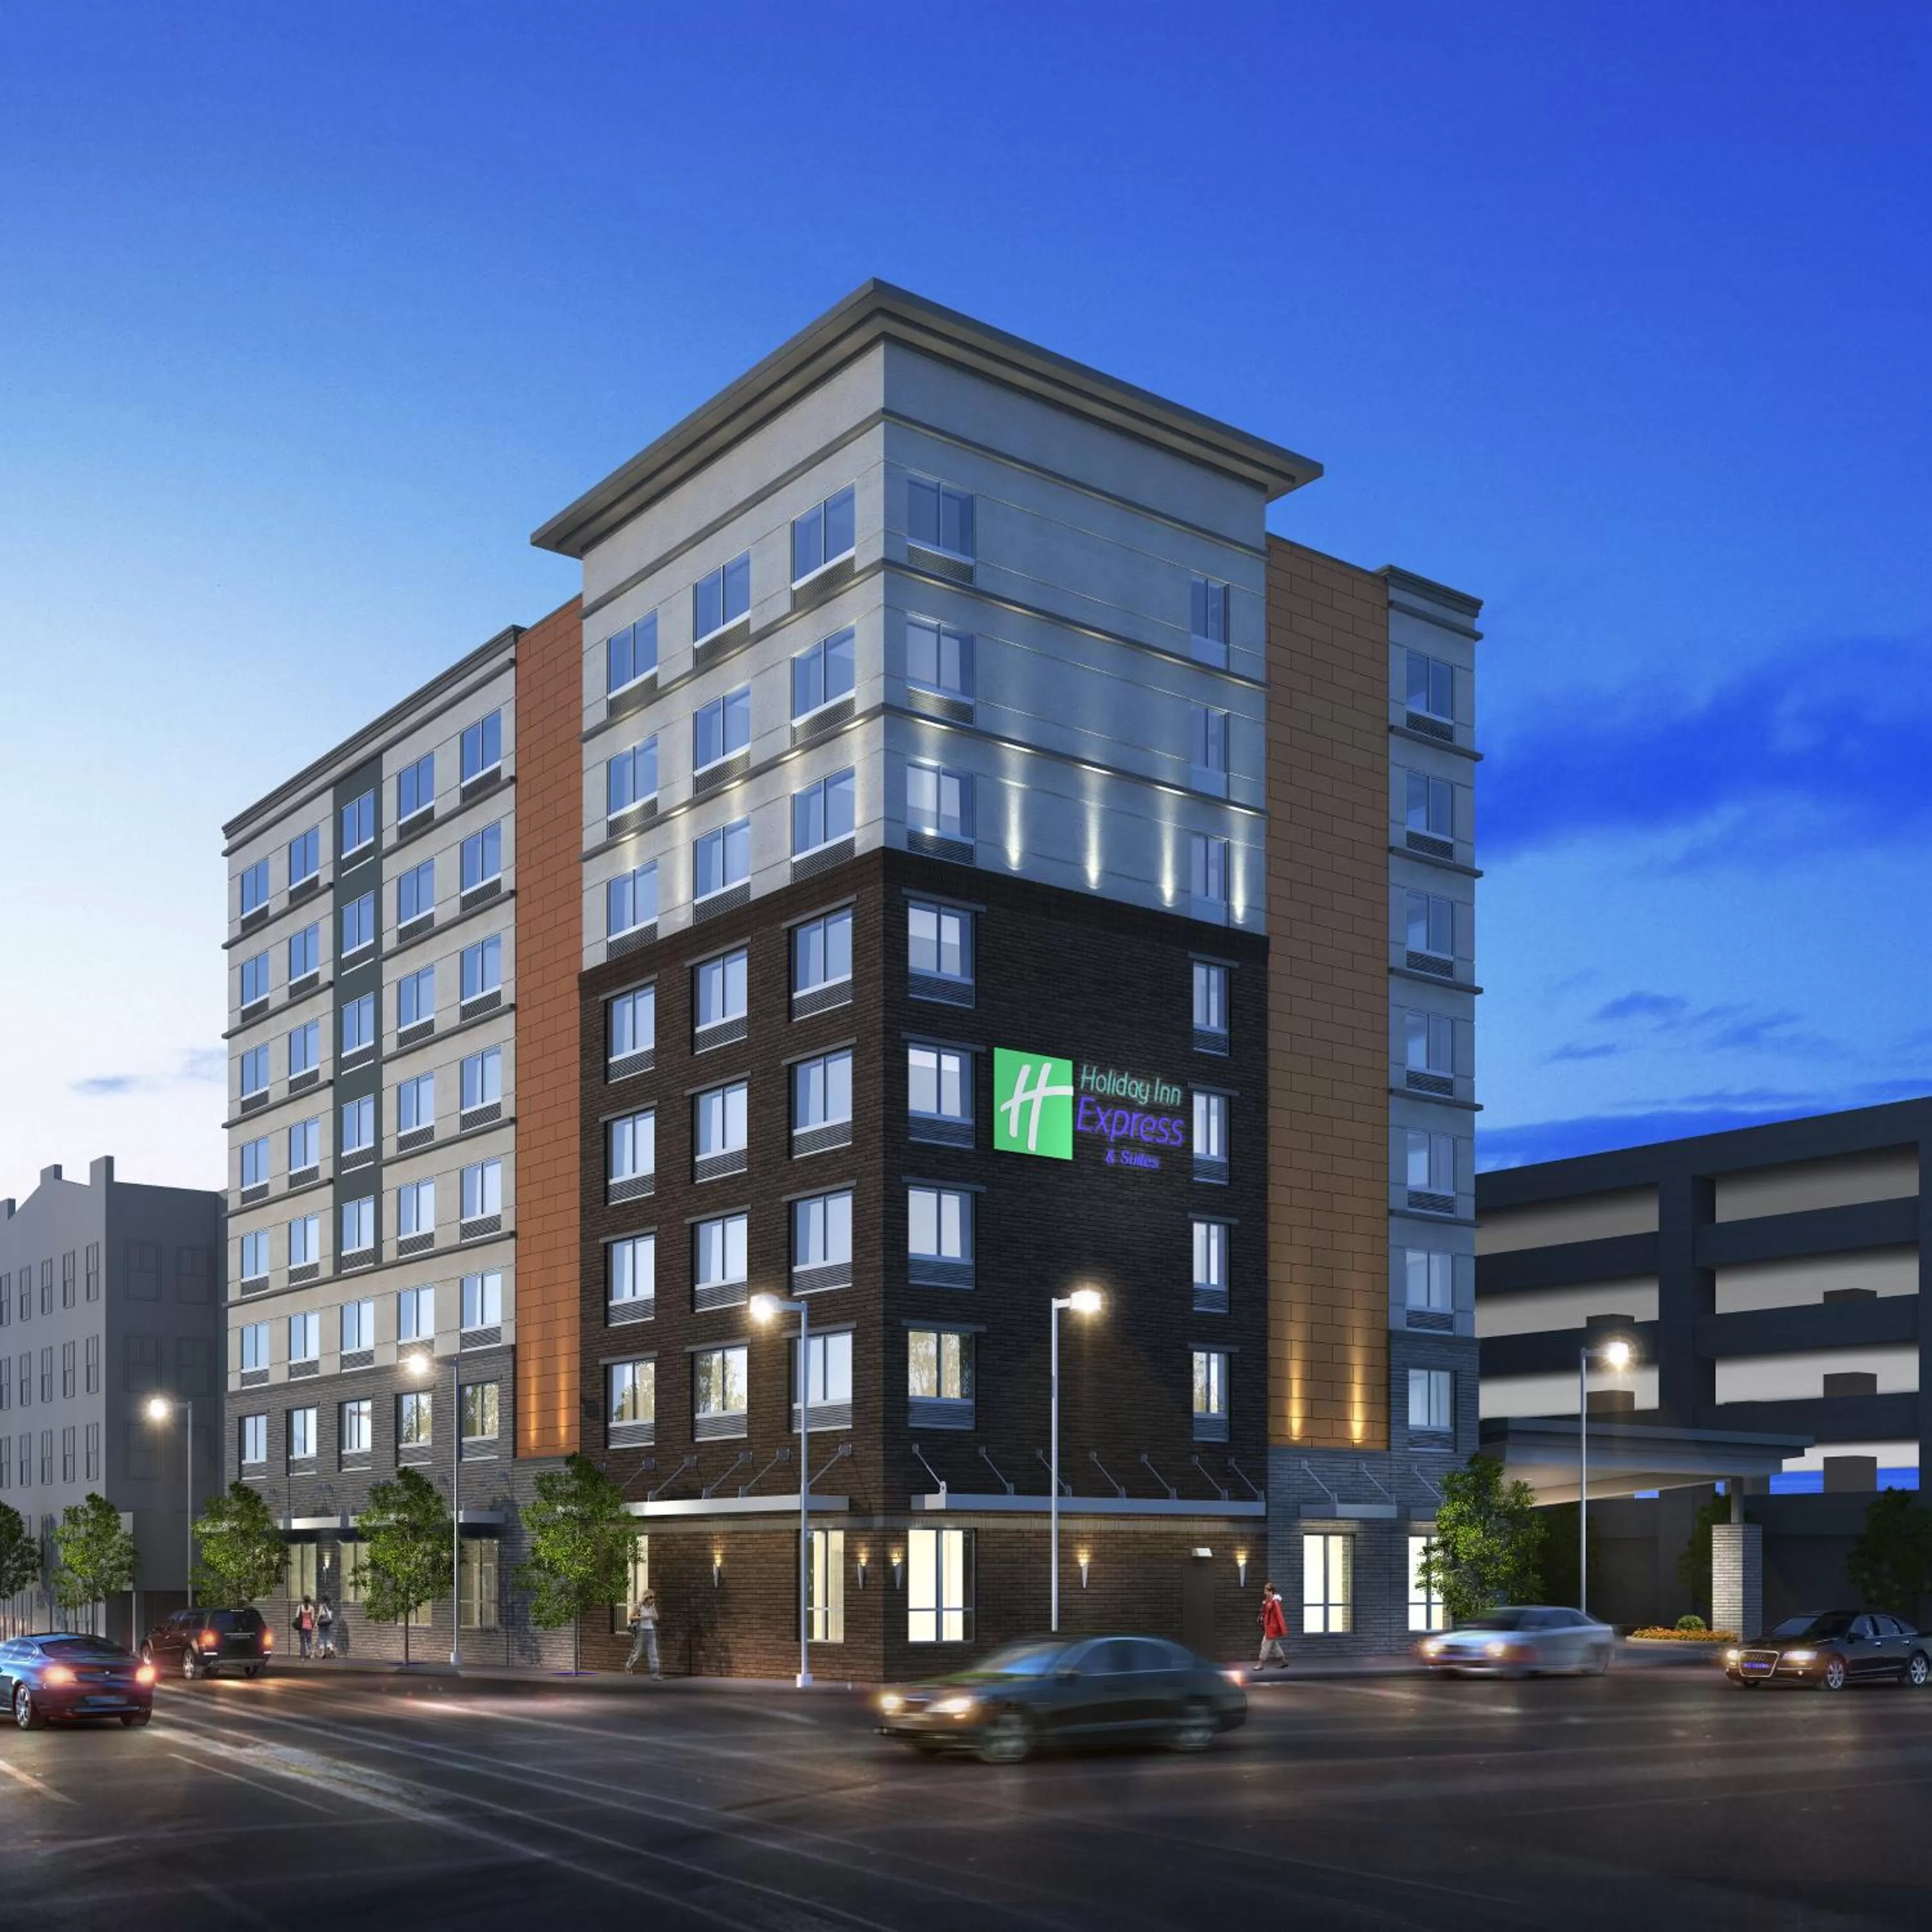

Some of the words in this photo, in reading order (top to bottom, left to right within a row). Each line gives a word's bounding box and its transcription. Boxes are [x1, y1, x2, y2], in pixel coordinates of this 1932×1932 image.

[999, 1063, 1074, 1151] H
[1080, 1064, 1150, 1105] Holiday
[1154, 1077, 1181, 1106] Inn
[1075, 1096, 1185, 1146] Express
[1105, 1149, 1115, 1164] &
